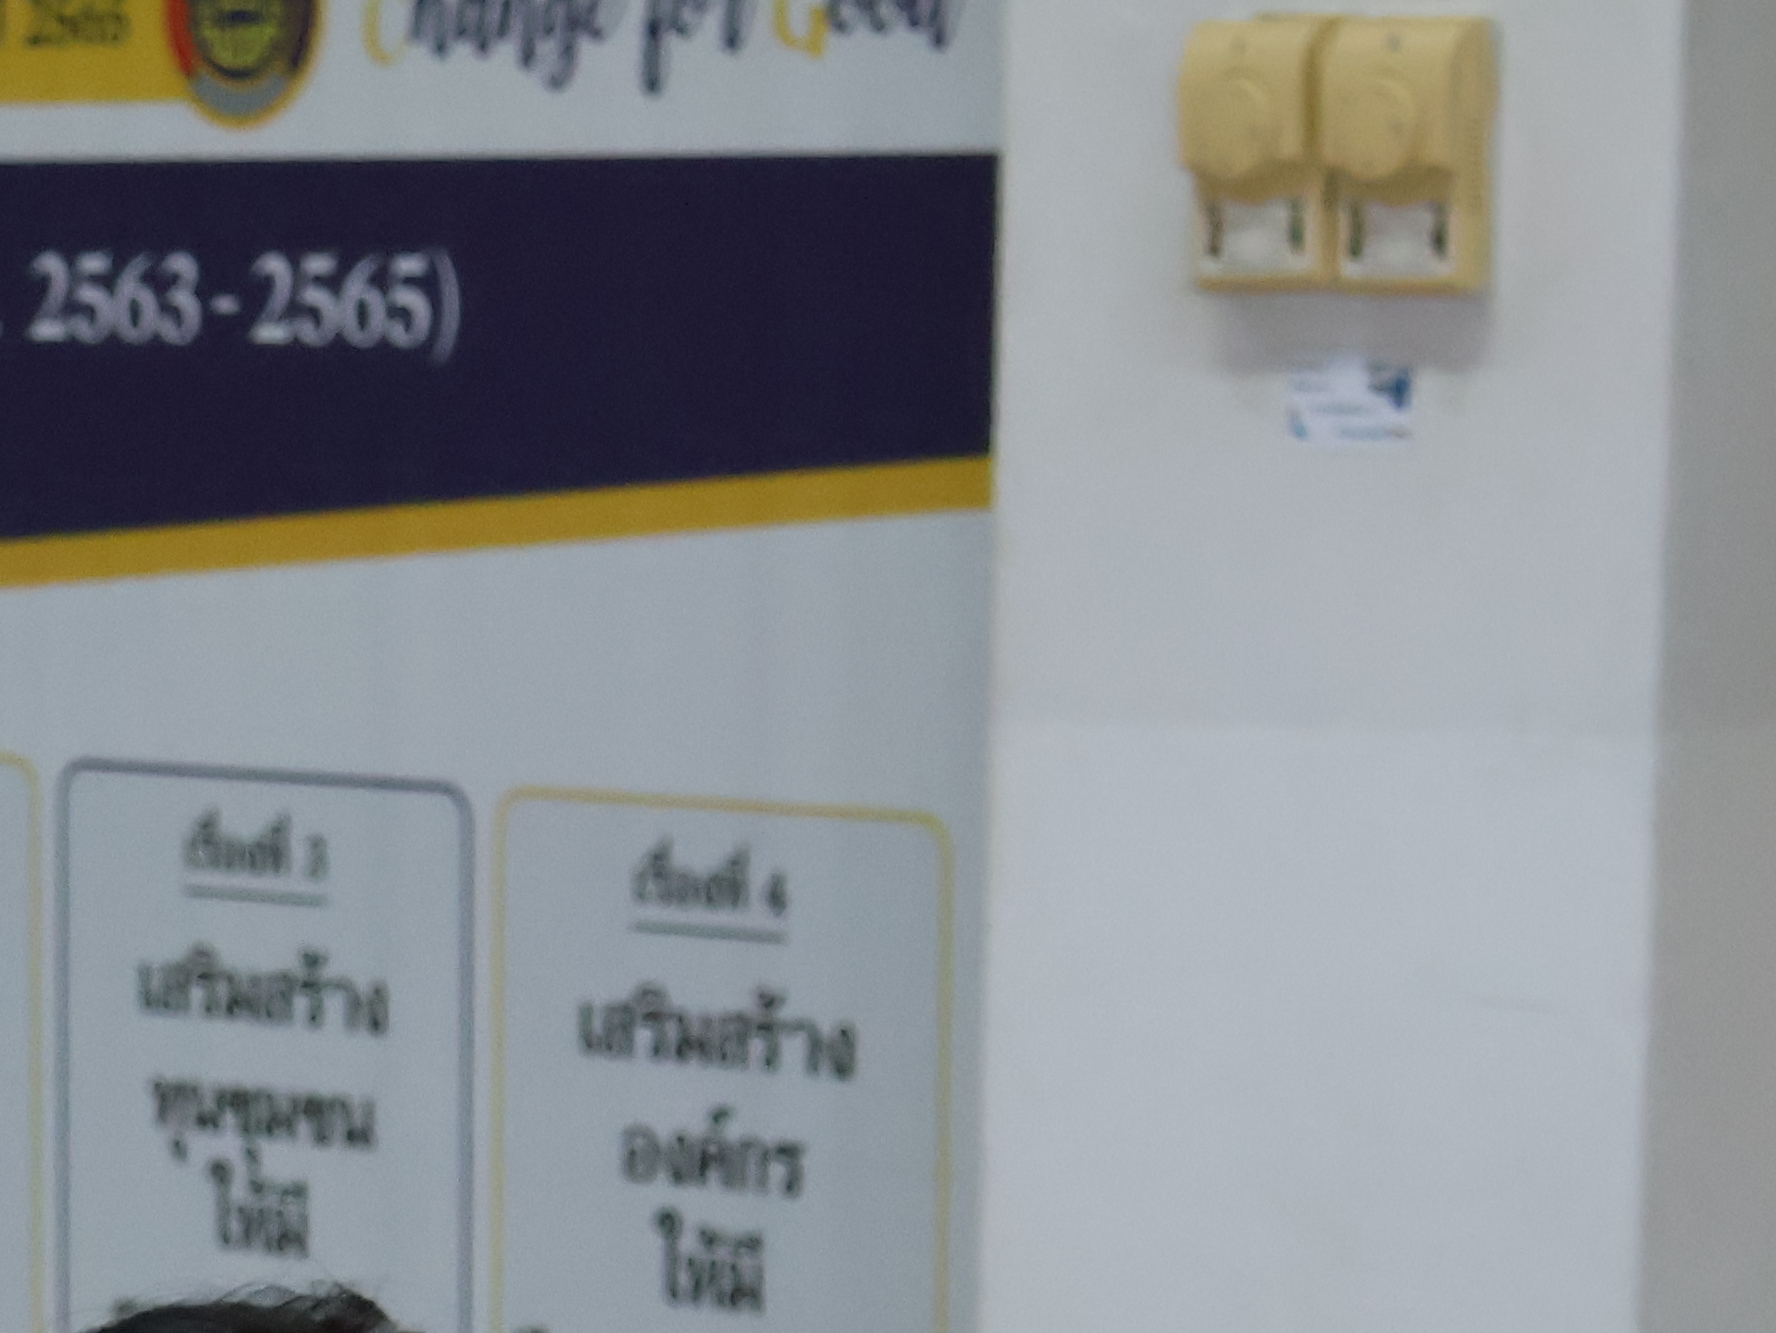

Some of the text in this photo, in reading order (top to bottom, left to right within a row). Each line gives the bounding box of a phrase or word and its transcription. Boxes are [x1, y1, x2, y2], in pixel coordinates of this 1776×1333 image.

[137, 941, 390, 1038] เสริมสร้าง
[578, 981, 858, 1080] เสริมสร้าง
[621, 1106, 807, 1199] องค์กร
